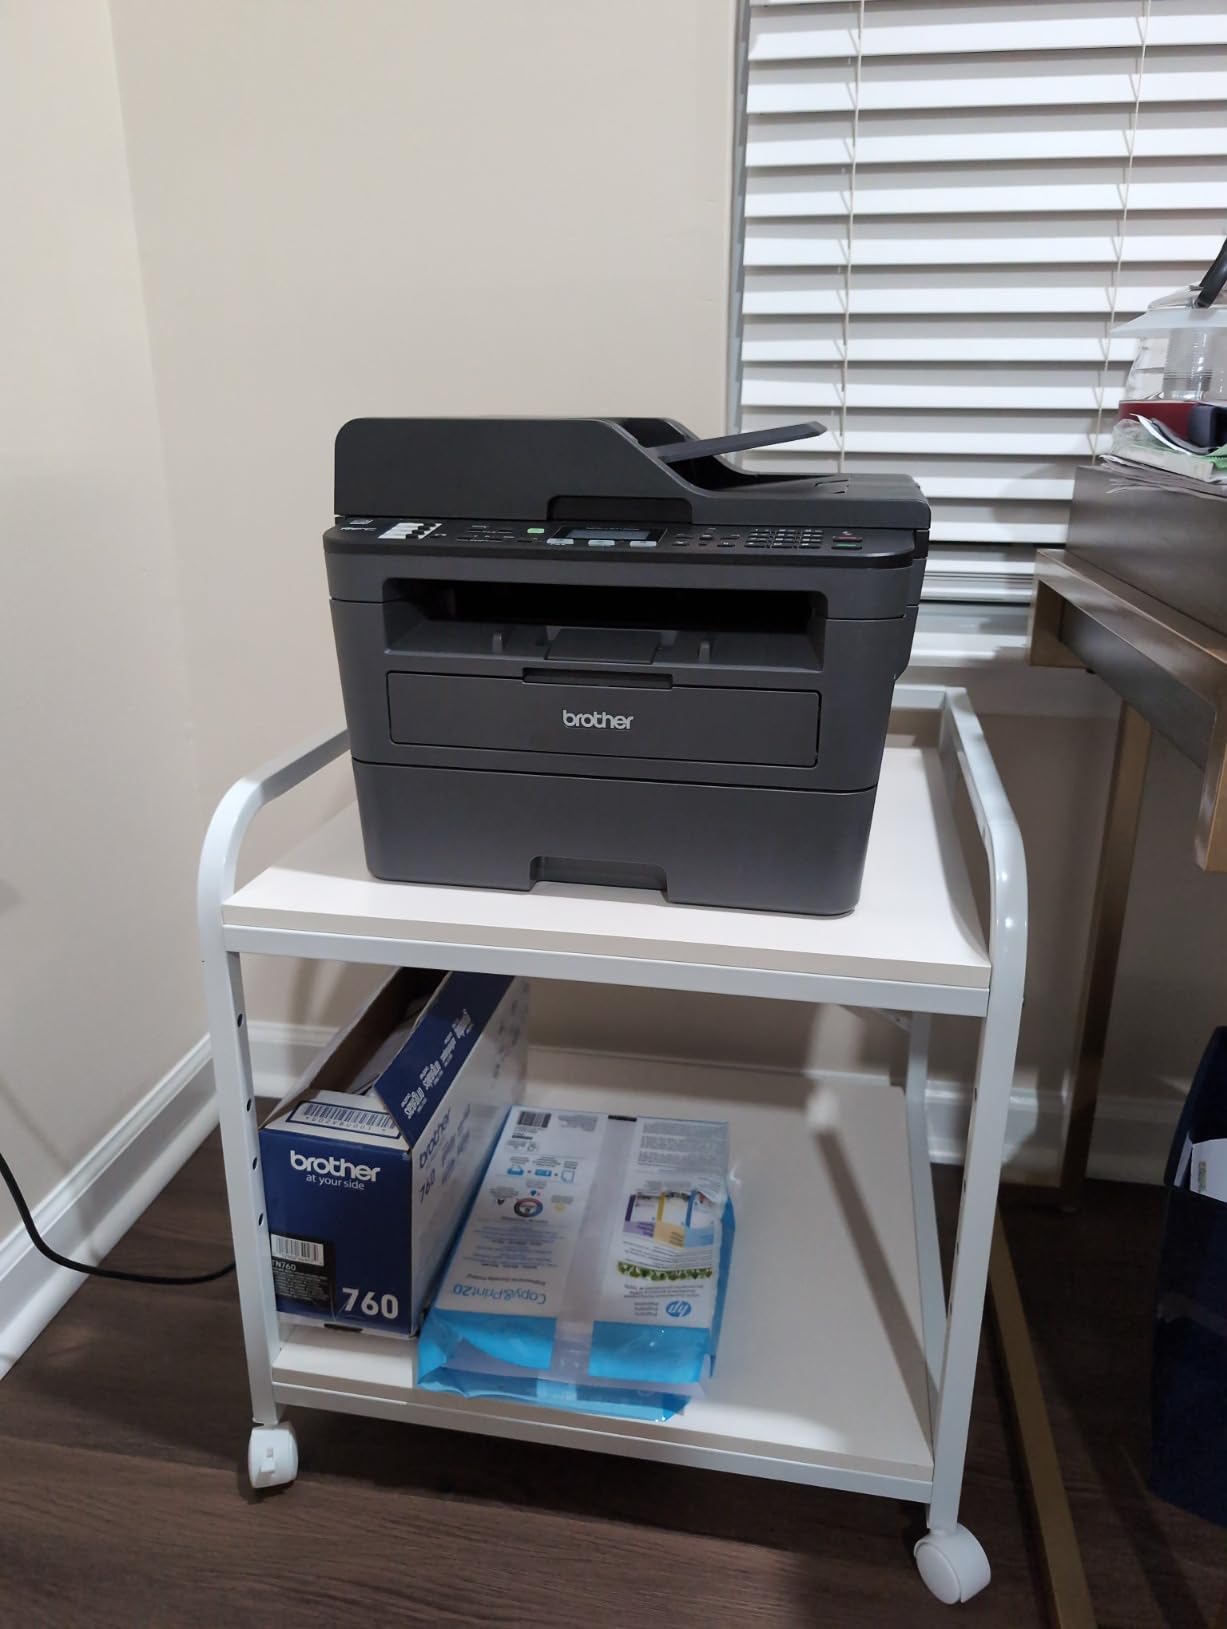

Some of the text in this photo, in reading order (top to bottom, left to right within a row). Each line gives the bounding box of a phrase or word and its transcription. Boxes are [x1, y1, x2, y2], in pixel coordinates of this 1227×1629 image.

[562, 709, 634, 729] brother
[290, 1149, 381, 1182] brother
[305, 1174, 366, 1190] at your side
[342, 1287, 399, 1319] 760
[453, 1283, 547, 1304] Copy&Print20
